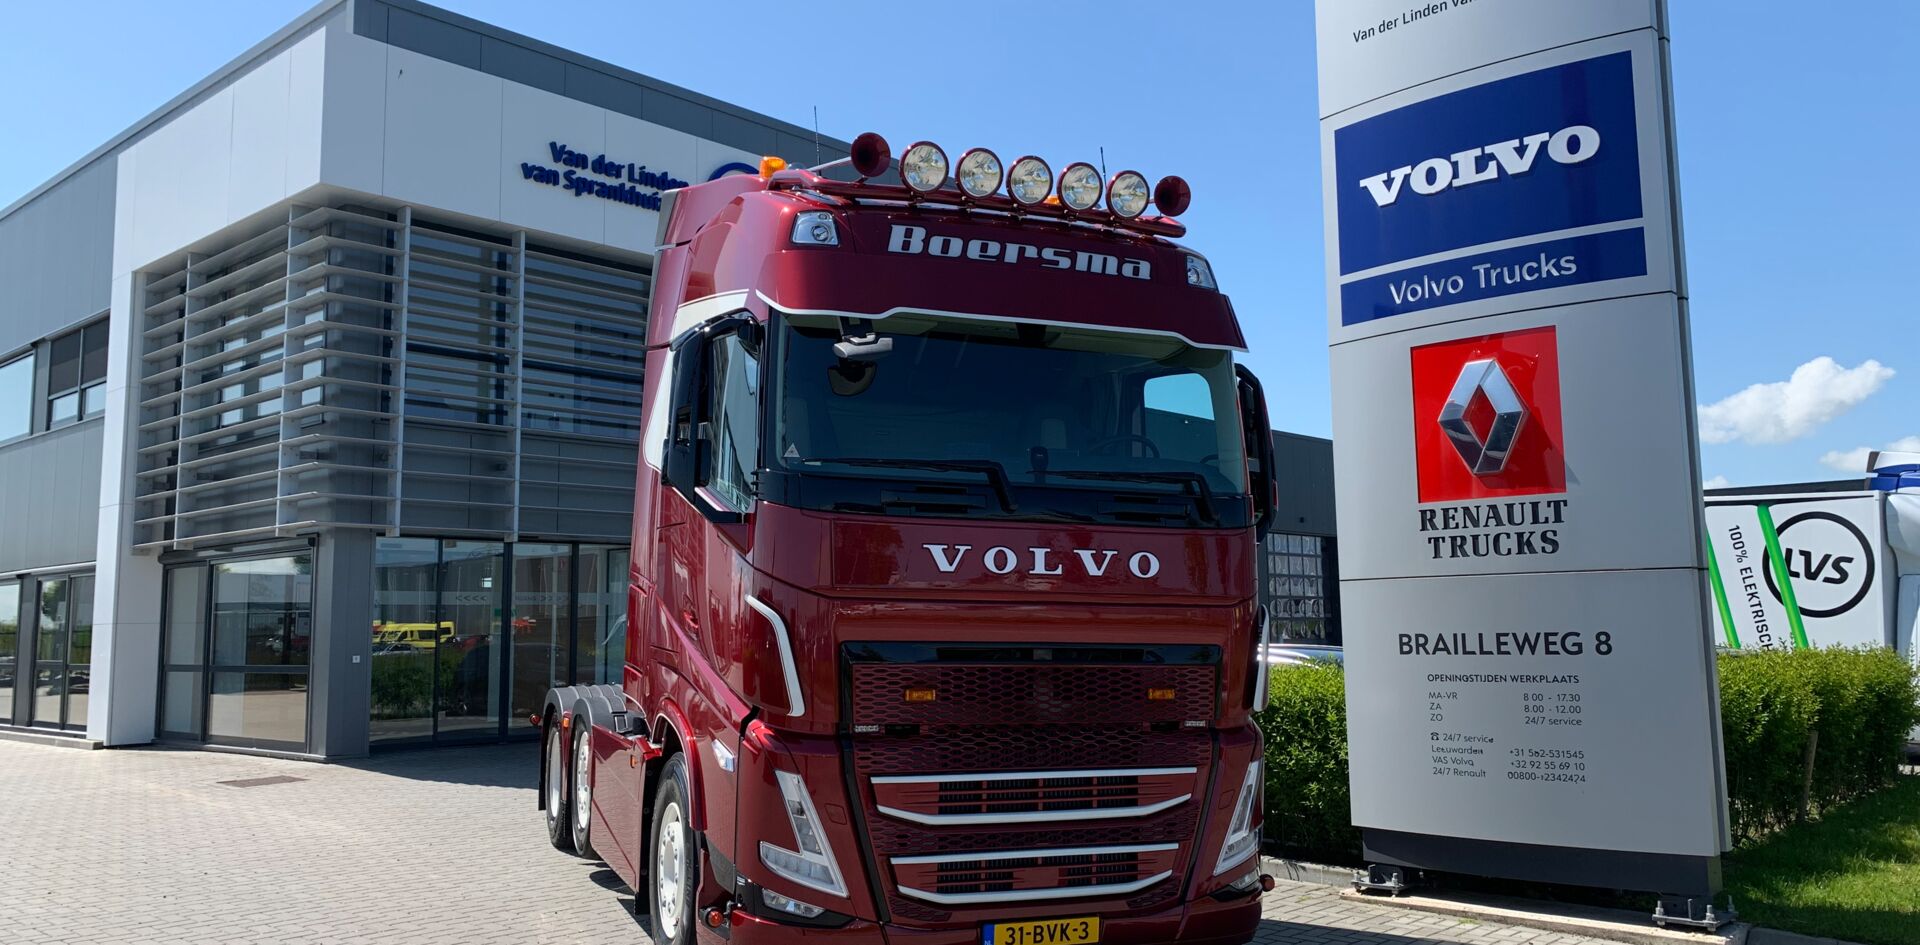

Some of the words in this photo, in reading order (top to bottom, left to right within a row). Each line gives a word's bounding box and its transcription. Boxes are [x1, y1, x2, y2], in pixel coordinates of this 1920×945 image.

[1352, 27, 1375, 43] Van
[1378, 18, 1399, 33] der
[1402, 1, 1448, 24] Linden
[549, 141, 589, 169] Van
[591, 154, 625, 179] der
[1360, 125, 1600, 207] VOLVO
[521, 162, 560, 186] van
[887, 224, 1151, 280] Boersma
[1390, 275, 1464, 305] Volvo
[1472, 252, 1577, 289] Trucks
[1418, 499, 1568, 532] RENAULT
[1428, 529, 1560, 559] TRUCKS
[1728, 524, 1748, 564] 100%
[922, 544, 1160, 578] VOLVO
[1784, 547, 1855, 585] LVS
[1398, 631, 1583, 656] BRAILLEWEG
[1594, 631, 1613, 656] 8
[1427, 673, 1507, 683] OPENINGSTIJDEN
[1510, 674, 1580, 684] WERKPLAATS
[1428, 692, 1458, 700] MA-VR
[1523, 693, 1544, 702] 800
[1556, 693, 1581, 702] 17.30
[1429, 703, 1442, 711] ZA
[1524, 704, 1545, 713] 8.00
[1555, 705, 1582, 714] 12.00
[1430, 713, 1443, 722] ZO
[1525, 716, 1546, 725] 24/7
[1548, 717, 1582, 726] service
[1443, 733, 1461, 743] 24/7
[1432, 756, 1448, 765] VAS
[1529, 760, 1543, 769] 92
[1544, 761, 1556, 770] 55
[1558, 762, 1571, 770] 69
[1575, 762, 1585, 771] 10
[1432, 767, 1451, 776] 24/7
[1453, 768, 1486, 778] Renault
[1005, 921, 1089, 945] 31-BVK-3
